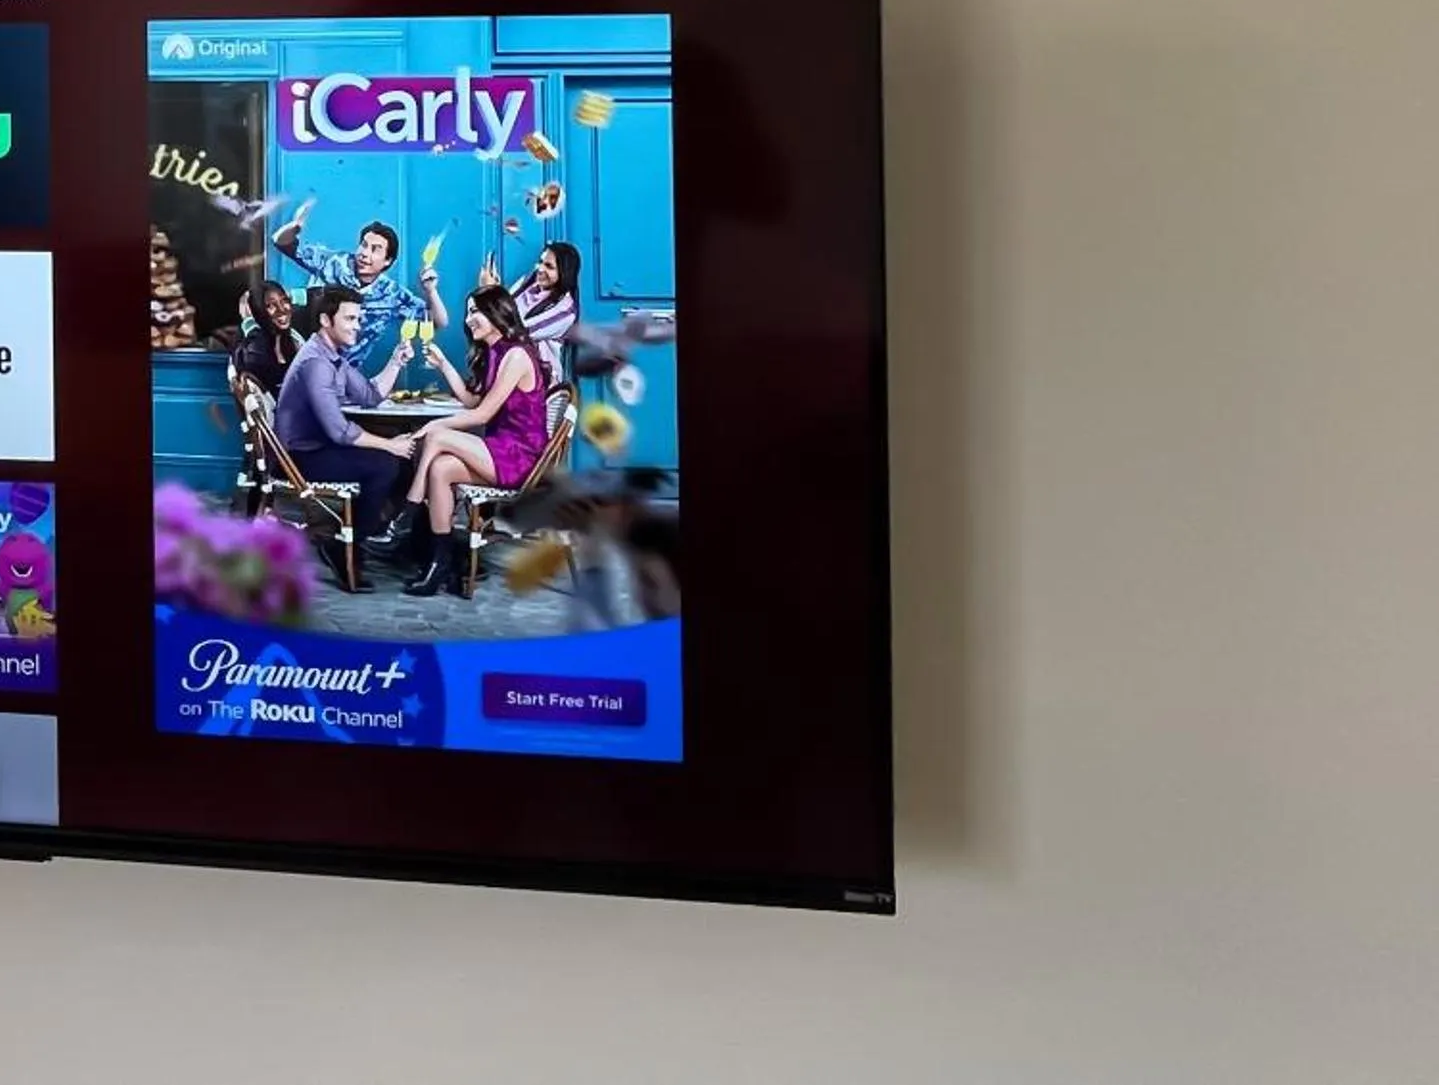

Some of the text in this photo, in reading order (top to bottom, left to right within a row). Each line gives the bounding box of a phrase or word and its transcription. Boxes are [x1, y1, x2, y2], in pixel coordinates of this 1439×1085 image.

[197, 39, 269, 61] Original
[289, 65, 527, 161] iCarly
[180, 638, 406, 695] Paramount+
[179, 698, 404, 730] on The Roku Channel
[505, 690, 623, 712] Start Free Trial
